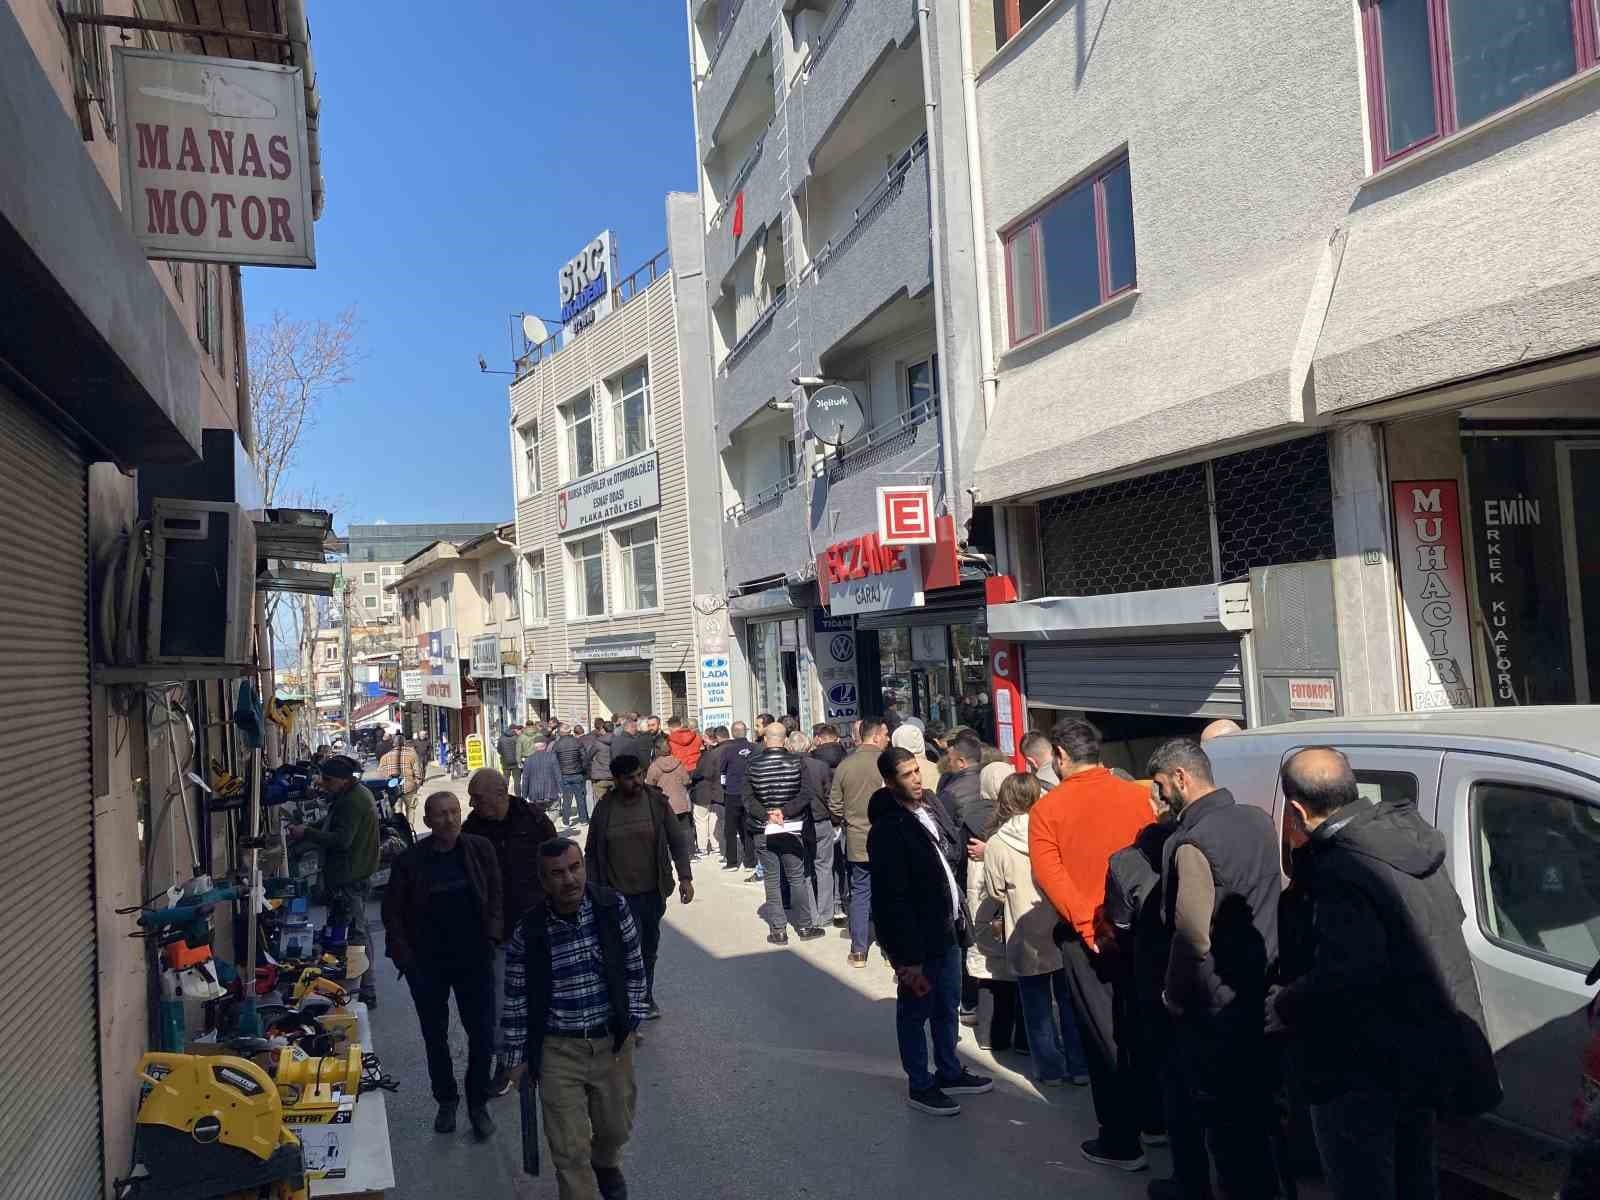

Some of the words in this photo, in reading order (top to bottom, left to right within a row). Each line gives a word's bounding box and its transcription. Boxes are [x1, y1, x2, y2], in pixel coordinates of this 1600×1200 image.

[136, 123, 292, 181] MANAS
[145, 187, 295, 242] MOTOR
[560, 239, 604, 304] SRC
[579, 511, 602, 525] PLAKA
[604, 496, 642, 518] ATÖLYESİ
[1484, 492, 1541, 525] EMİN
[701, 669, 729, 679] LADA
